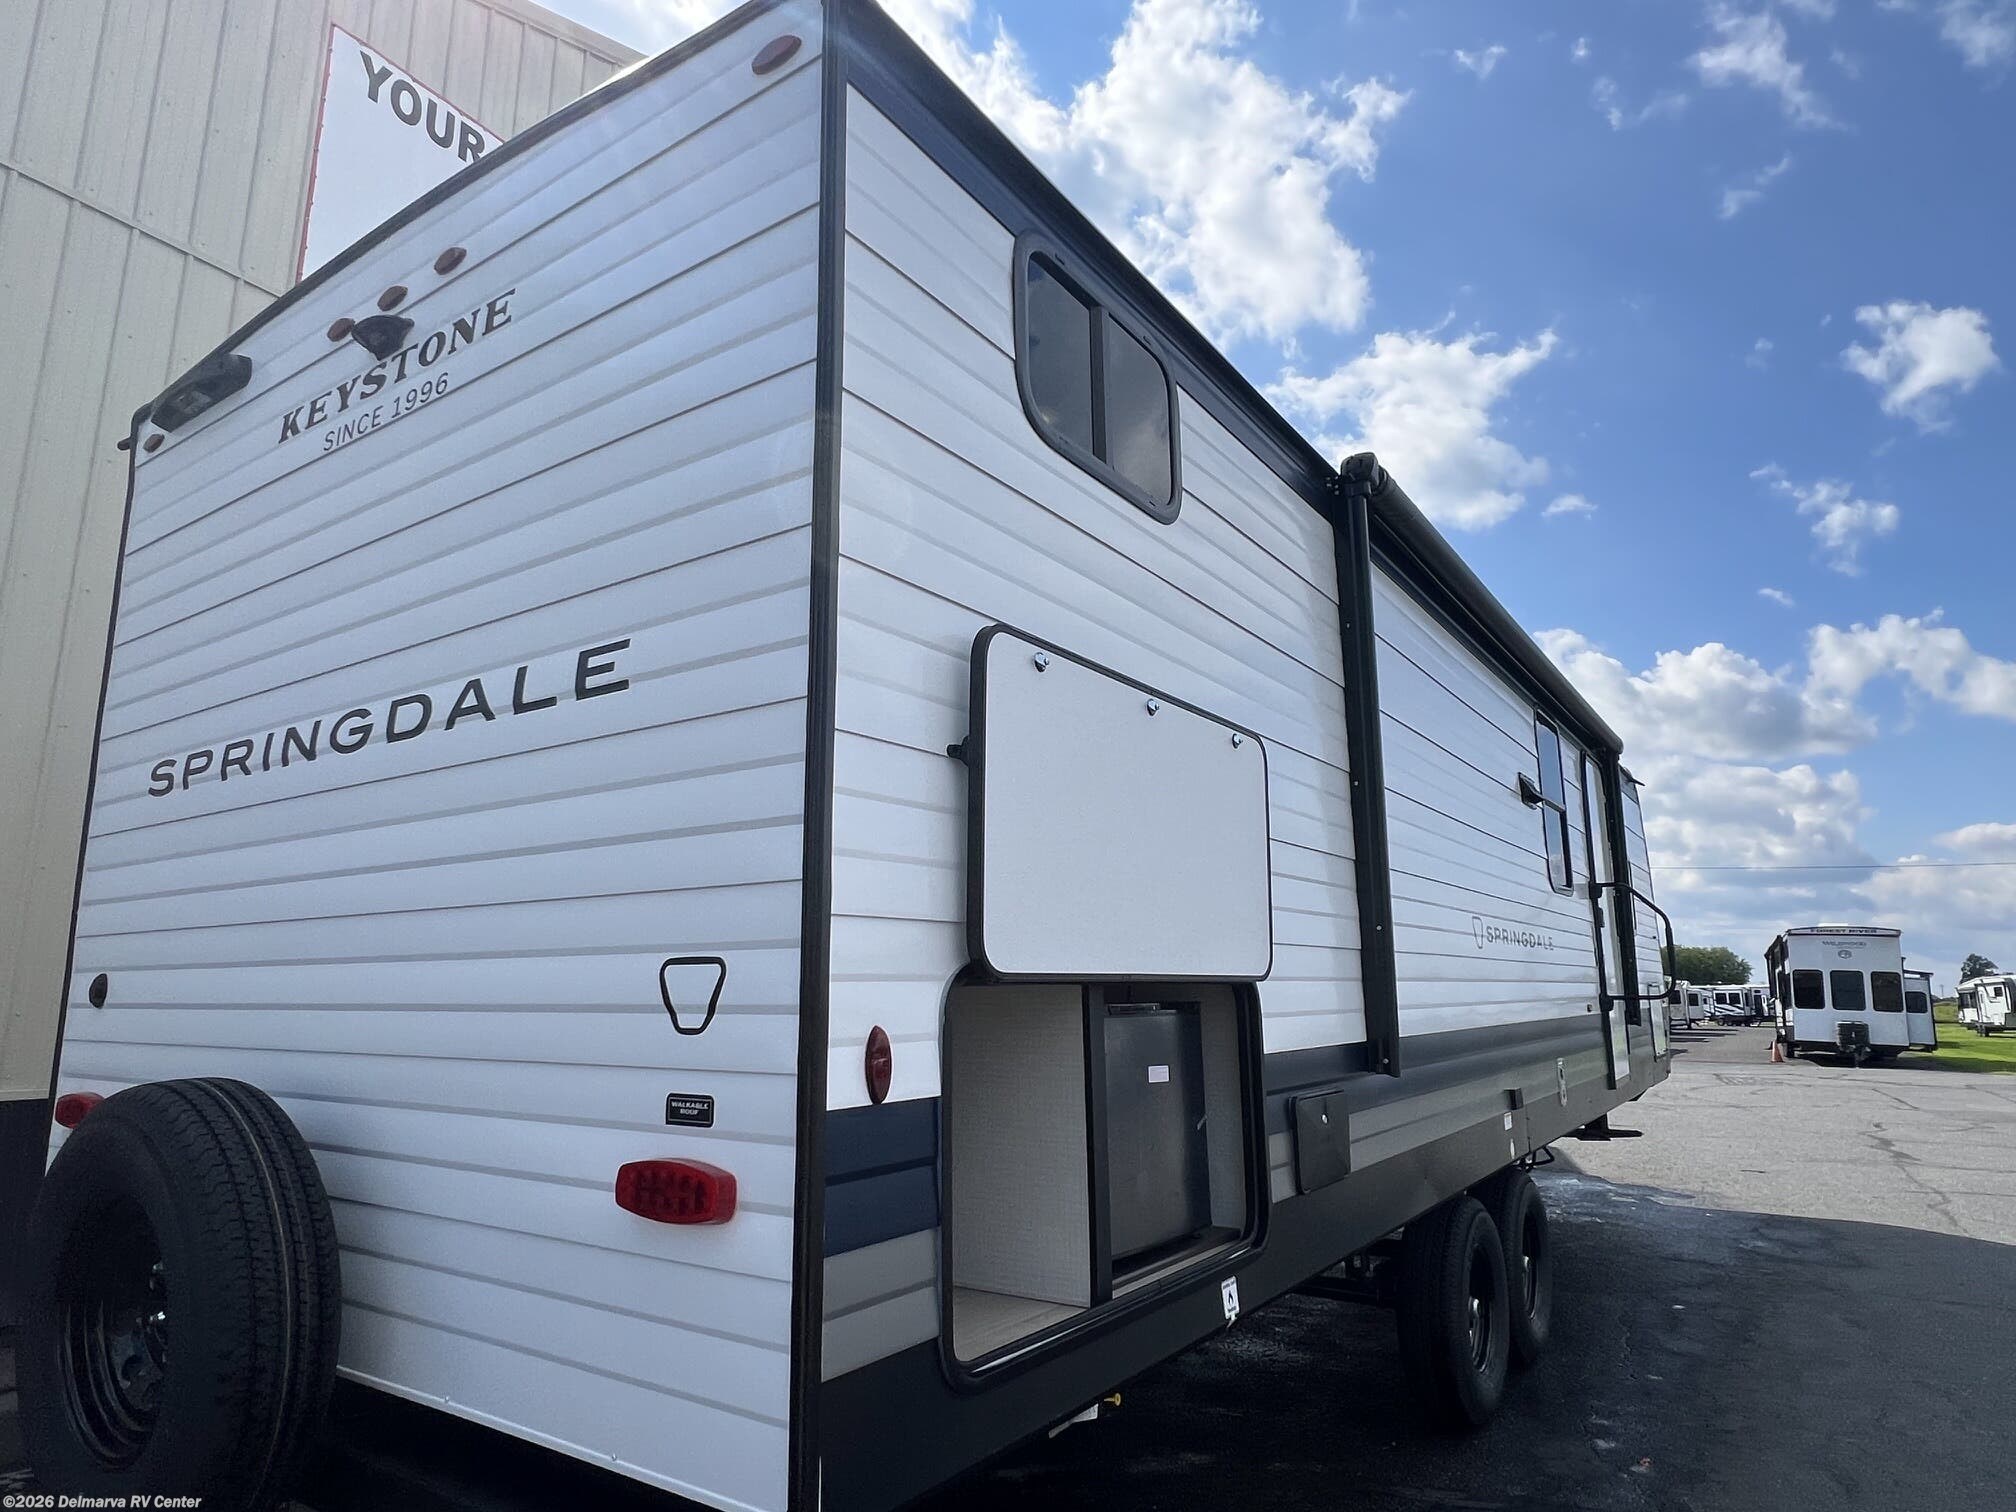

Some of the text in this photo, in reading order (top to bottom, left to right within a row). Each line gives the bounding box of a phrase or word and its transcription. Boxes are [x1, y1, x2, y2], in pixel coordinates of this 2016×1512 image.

[360, 50, 486, 163] YOUR
[278, 288, 516, 444] KEYSTONE
[323, 372, 449, 451] SINCE 1996
[148, 638, 632, 797] SPRINGDALE
[1485, 925, 1554, 951] SPRINGDALE
[671, 1101, 709, 1110] WALKABLE
